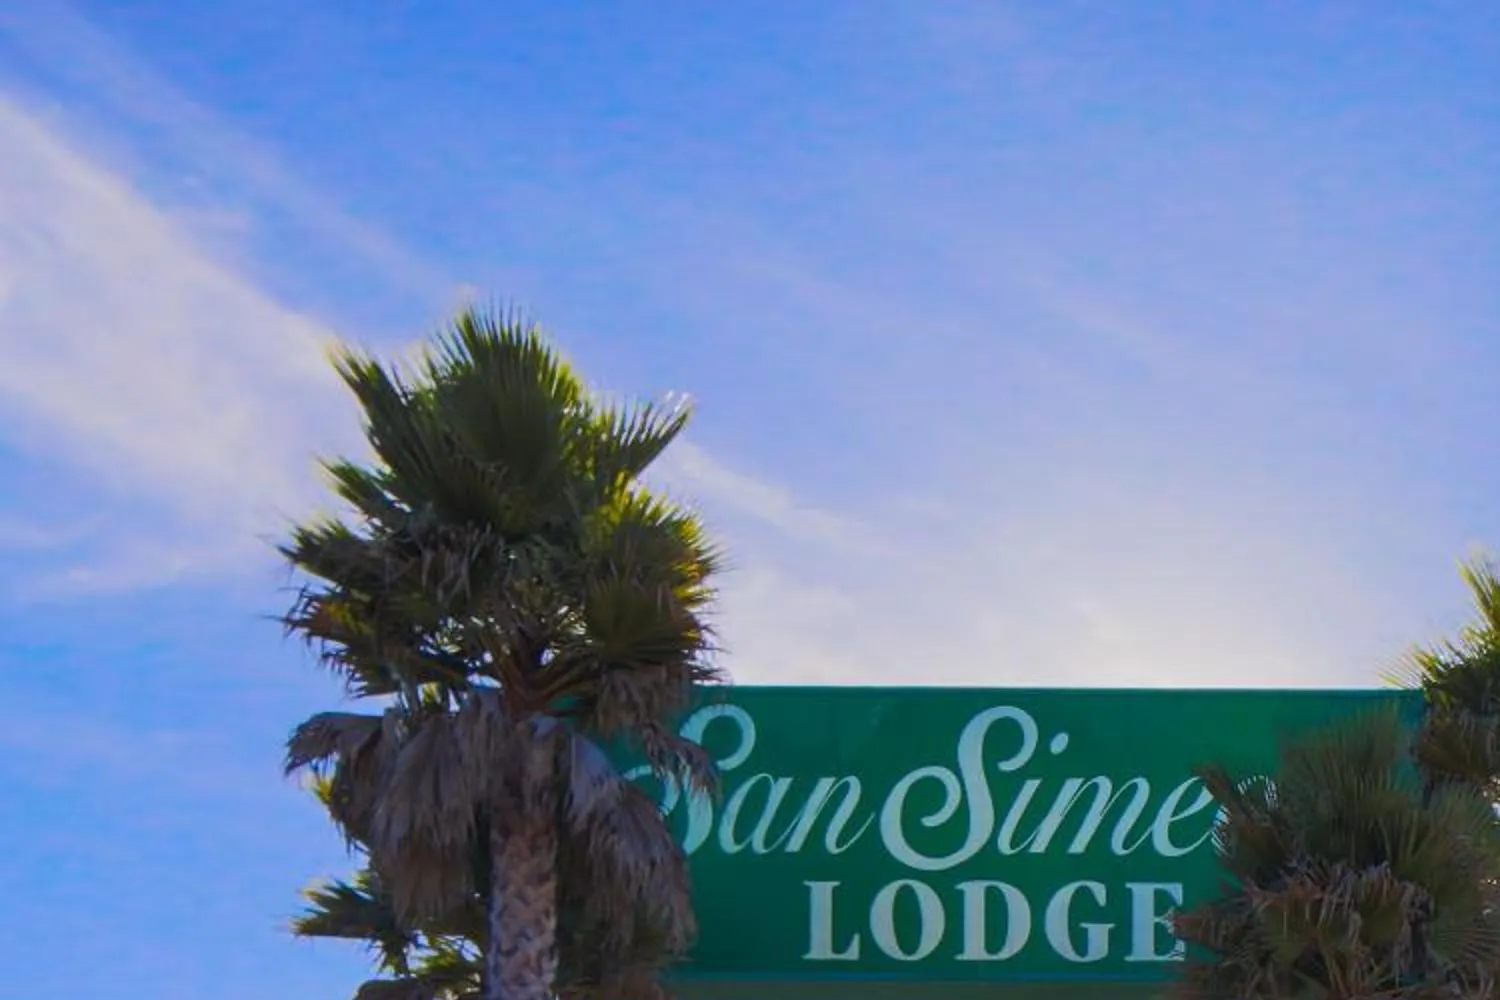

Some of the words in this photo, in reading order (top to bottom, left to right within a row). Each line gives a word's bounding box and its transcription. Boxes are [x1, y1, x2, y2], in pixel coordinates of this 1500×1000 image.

[624, 703, 875, 856] San
[880, 705, 1278, 871] Sime
[802, 878, 1185, 963] LODGE
